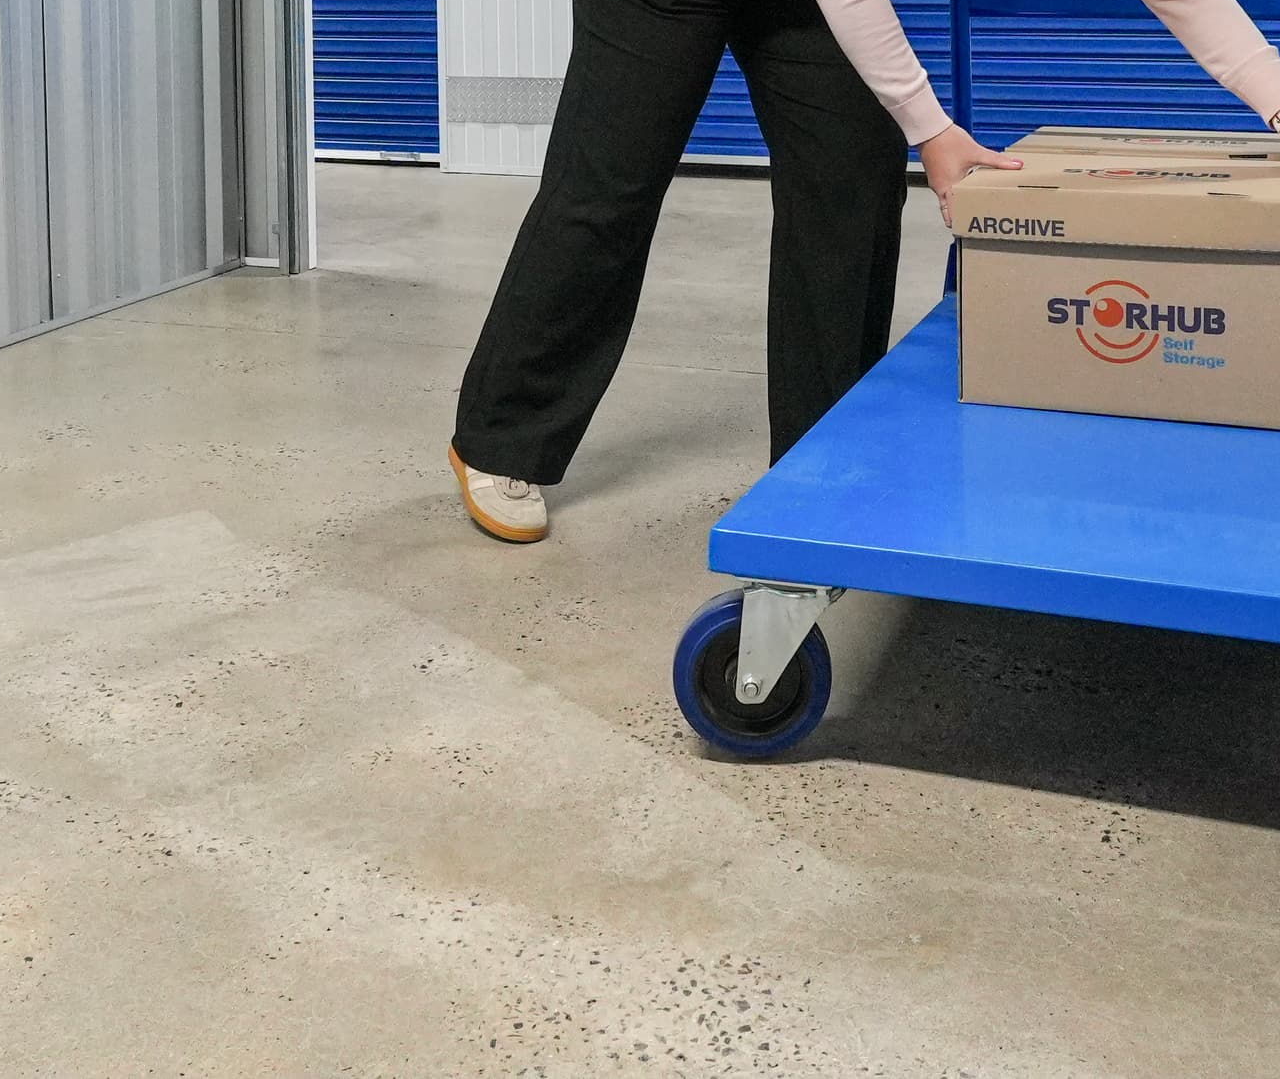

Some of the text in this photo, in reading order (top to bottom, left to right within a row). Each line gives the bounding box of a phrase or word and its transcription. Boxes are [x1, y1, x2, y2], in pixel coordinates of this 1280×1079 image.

[968, 217, 1065, 237] ARCHIVE
[1047, 297, 1226, 335] STORHUB
[1163, 337, 1195, 351] Self
[1163, 351, 1225, 369] Storage
